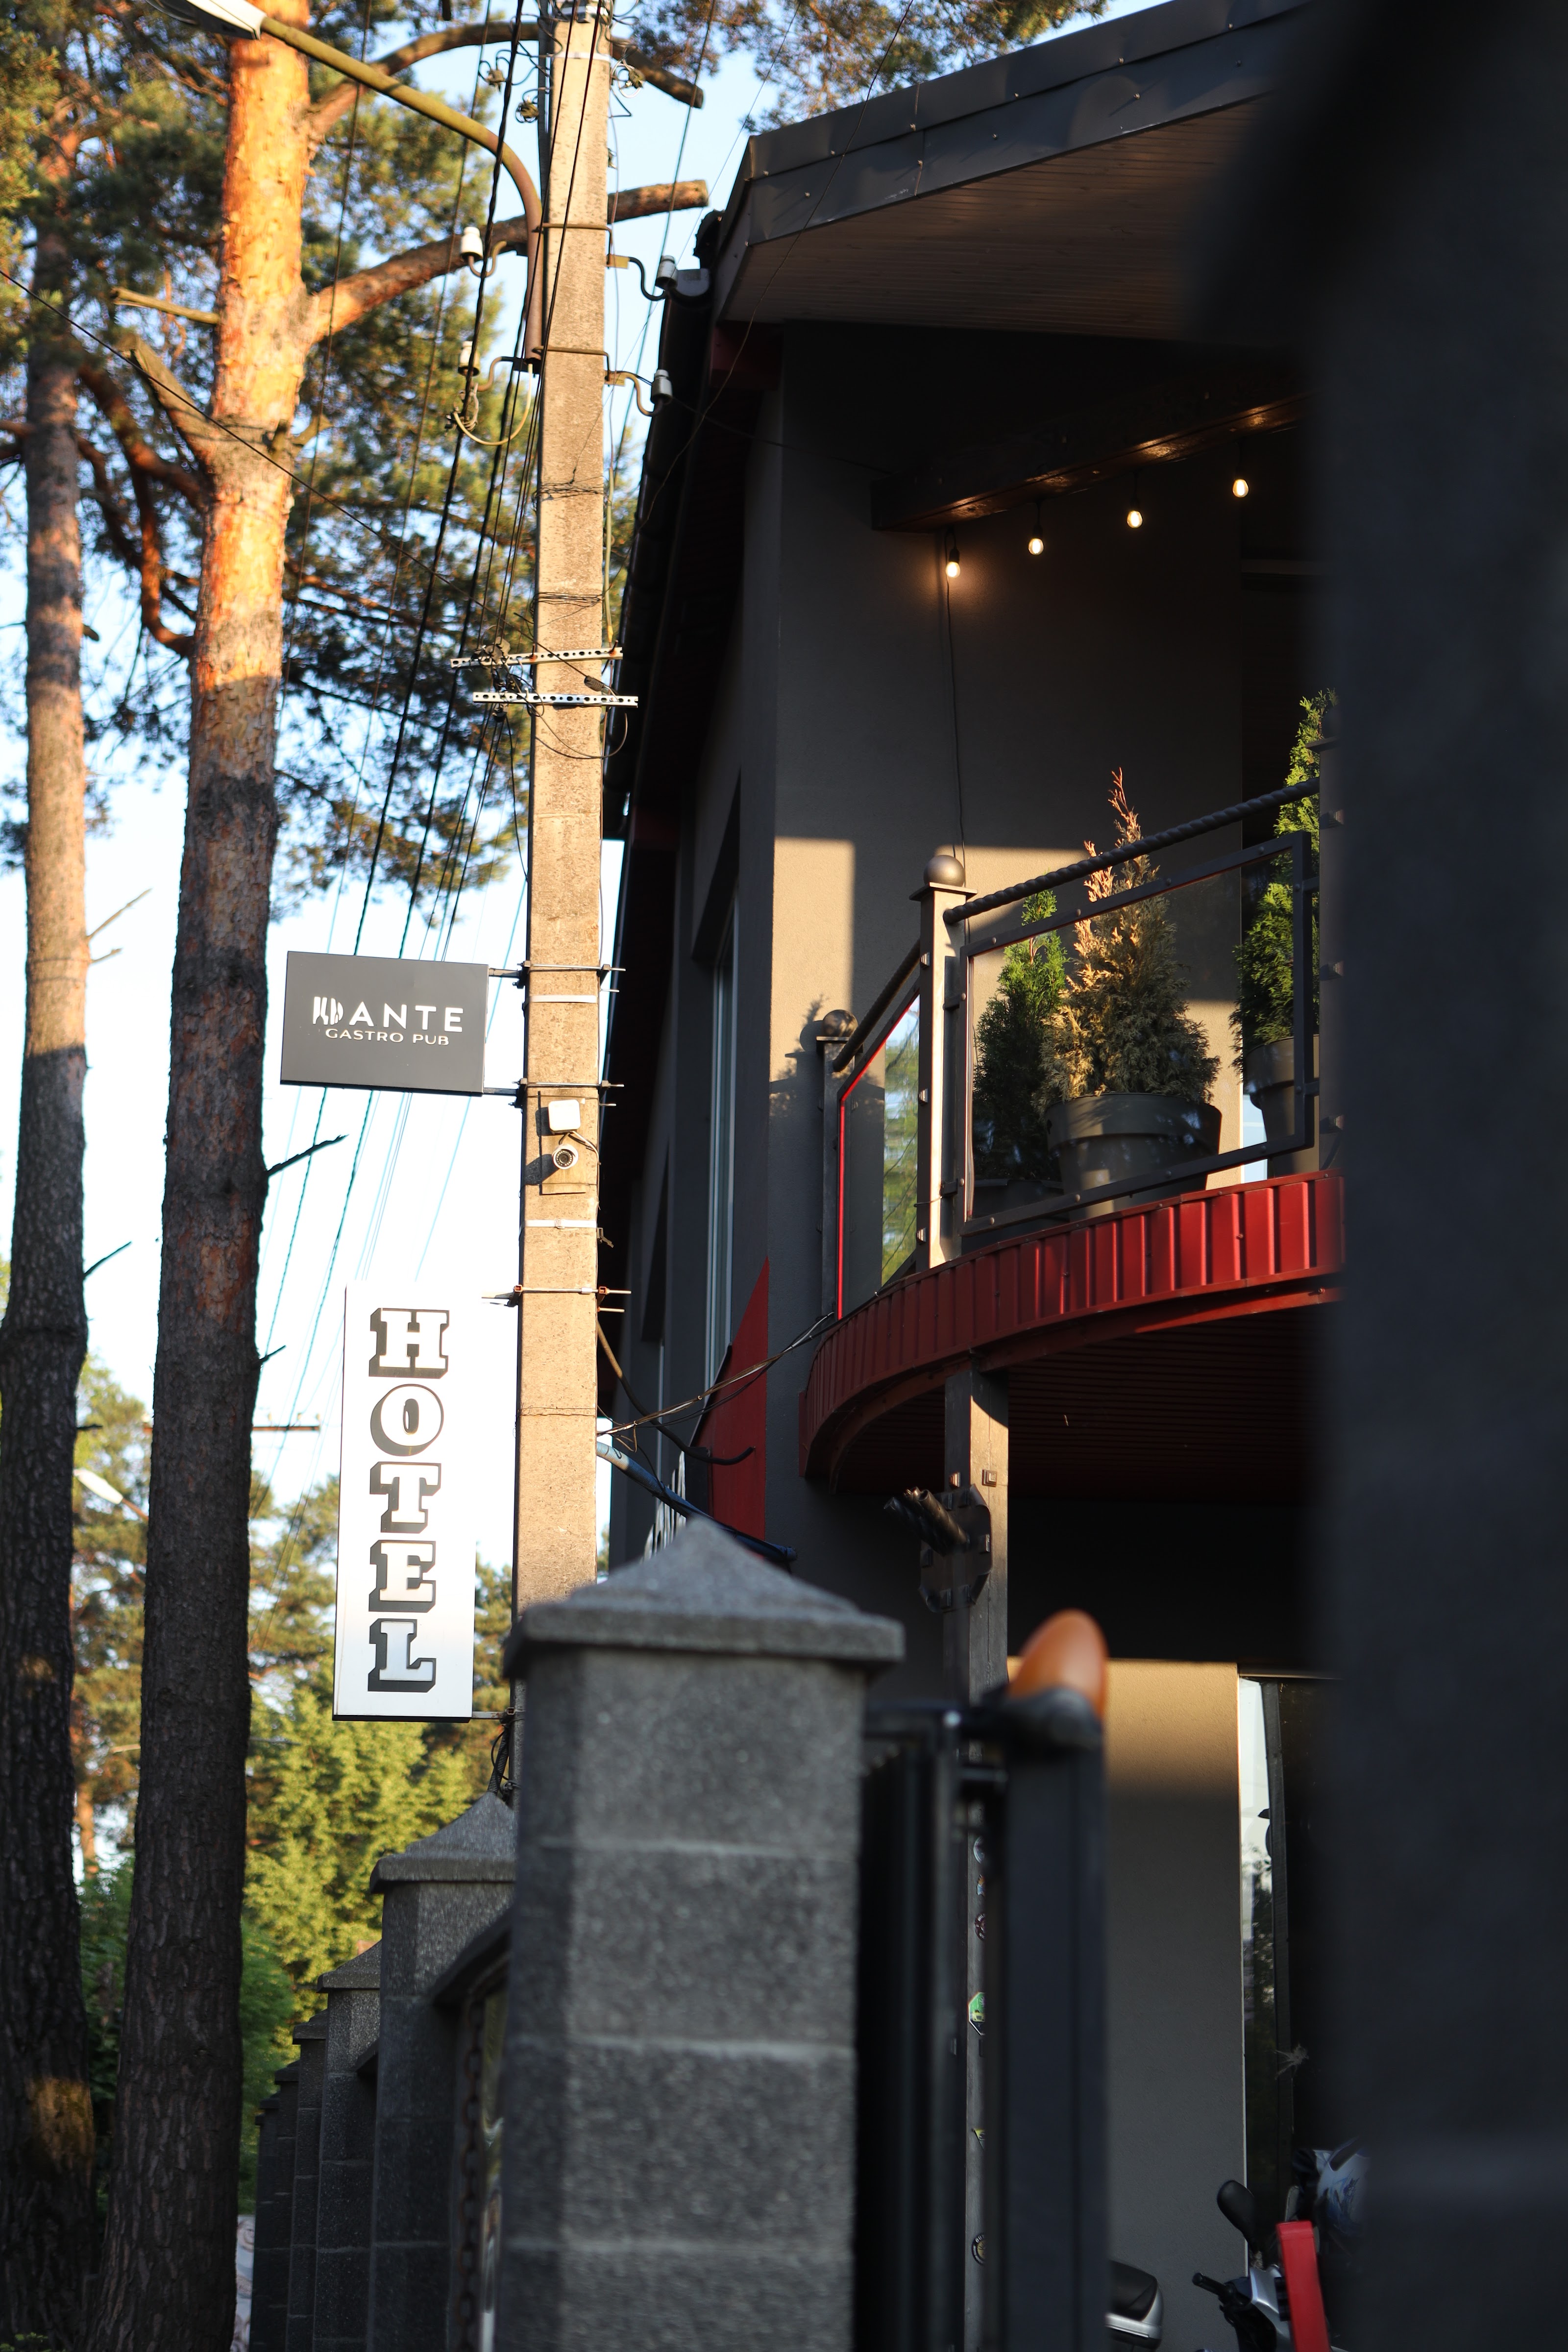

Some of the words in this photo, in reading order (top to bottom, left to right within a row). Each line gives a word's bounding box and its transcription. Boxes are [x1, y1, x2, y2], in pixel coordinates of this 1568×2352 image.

[325, 1028, 404, 1043] GASTRO
[412, 1033, 449, 1046] PUB
[368, 1307, 450, 1693] HOTEL
